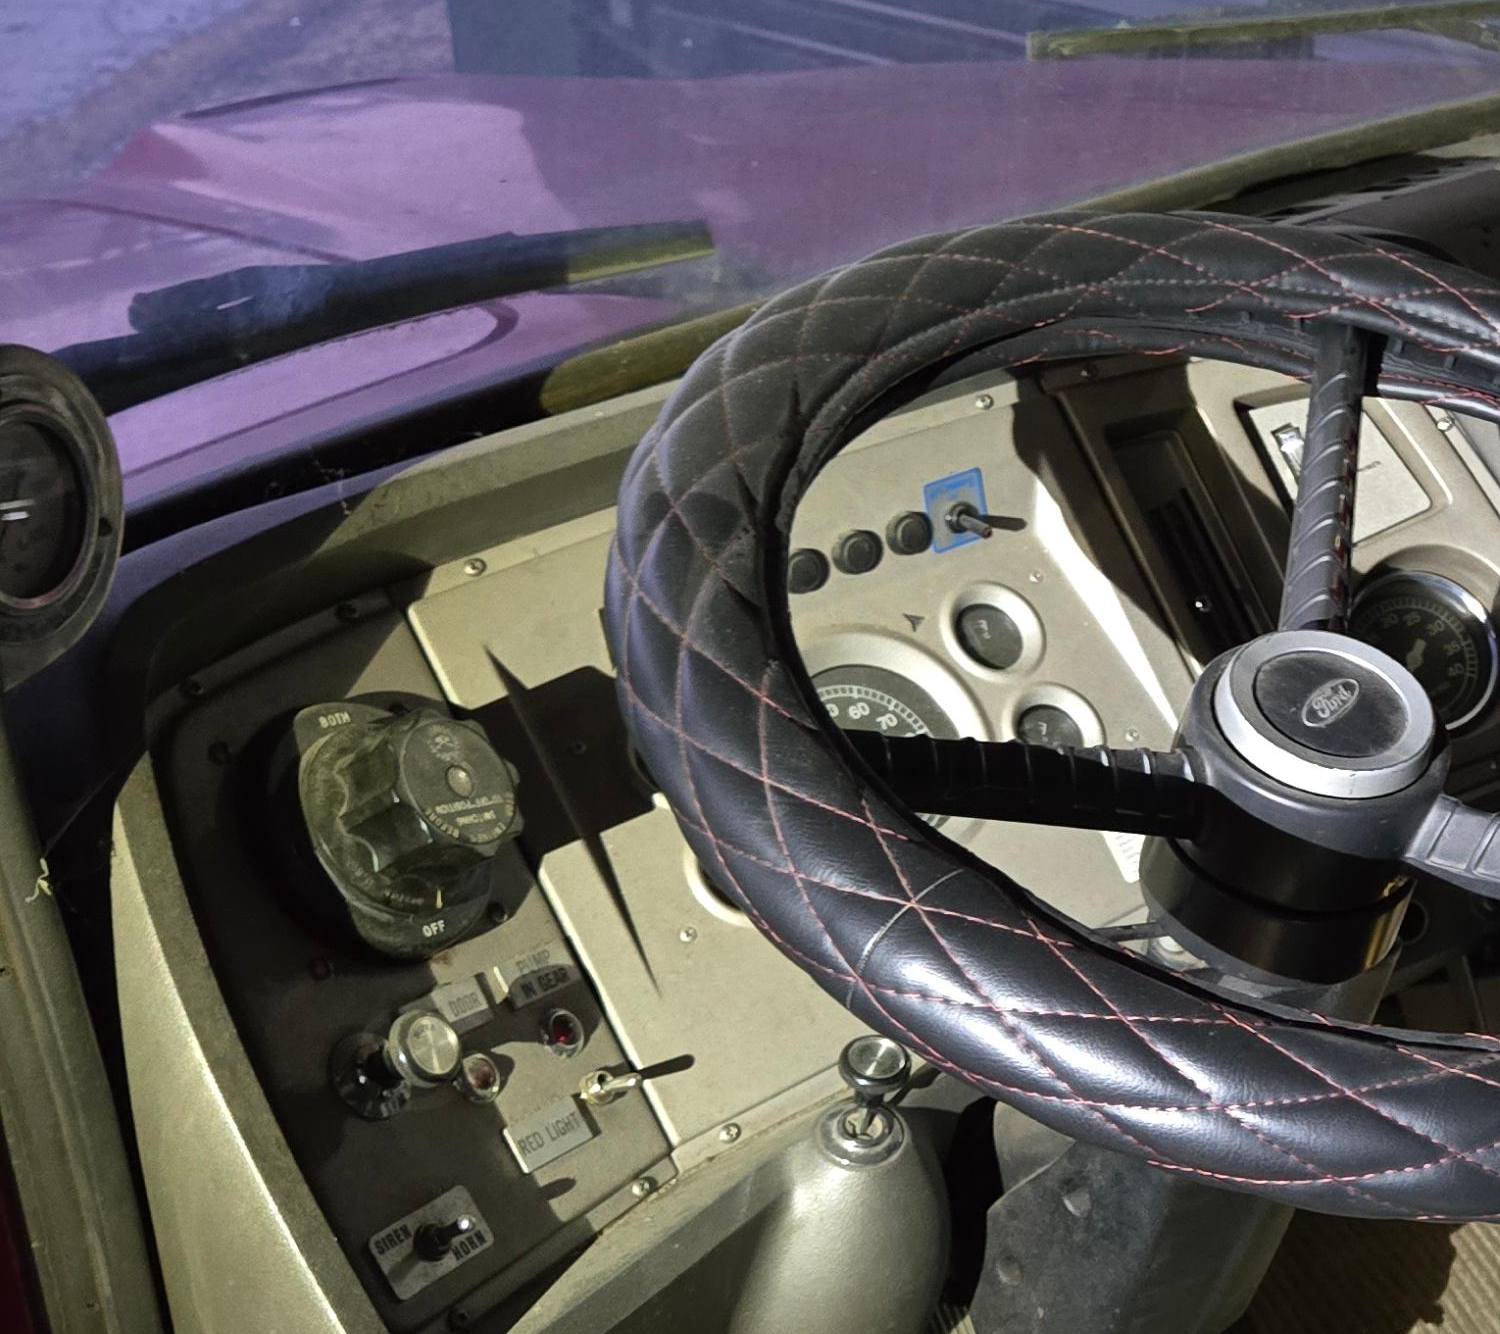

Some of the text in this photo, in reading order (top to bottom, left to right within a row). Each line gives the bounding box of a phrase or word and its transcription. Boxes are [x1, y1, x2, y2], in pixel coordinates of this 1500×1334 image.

[848, 701, 870, 720] 60
[1311, 684, 1352, 718] Ford
[318, 711, 351, 728] BOTH
[422, 919, 445, 937] OFF
[521, 967, 570, 999] IN GEAR
[448, 992, 481, 1017] DOOR
[517, 1111, 581, 1156] RED LIGHT
[451, 1229, 487, 1261] HORN
